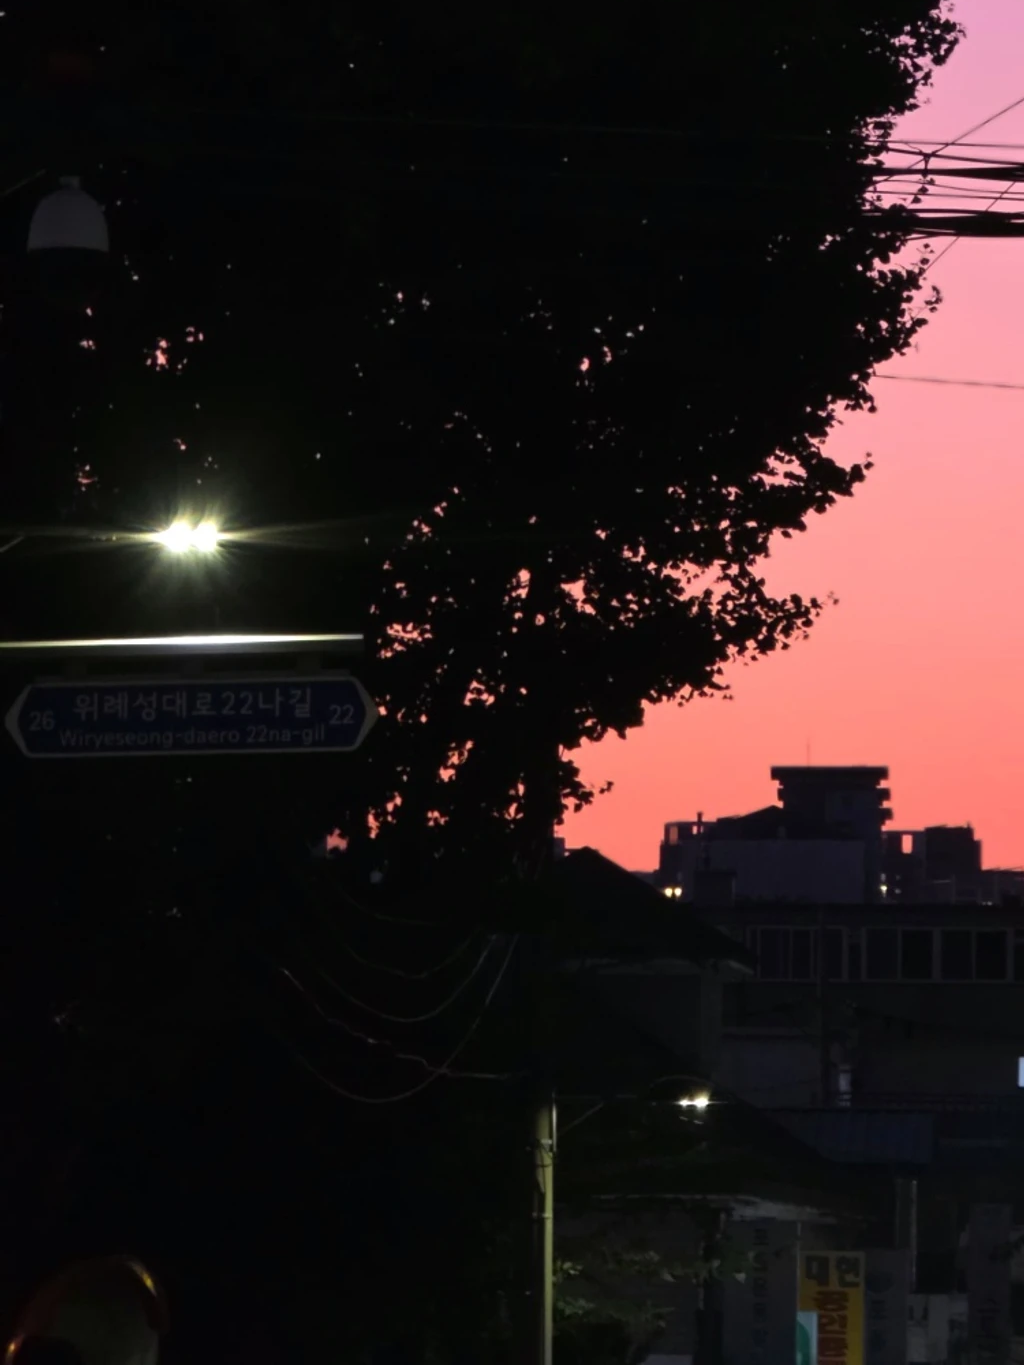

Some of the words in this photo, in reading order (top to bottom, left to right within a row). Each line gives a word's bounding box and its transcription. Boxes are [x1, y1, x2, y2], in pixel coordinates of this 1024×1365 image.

[73, 687, 313, 722] 위례성대로22나길
[328, 703, 356, 726] 22
[28, 710, 57, 732] 26
[58, 726, 241, 749] Wiryeseong-daero
[245, 723, 326, 746] 22na-gil
